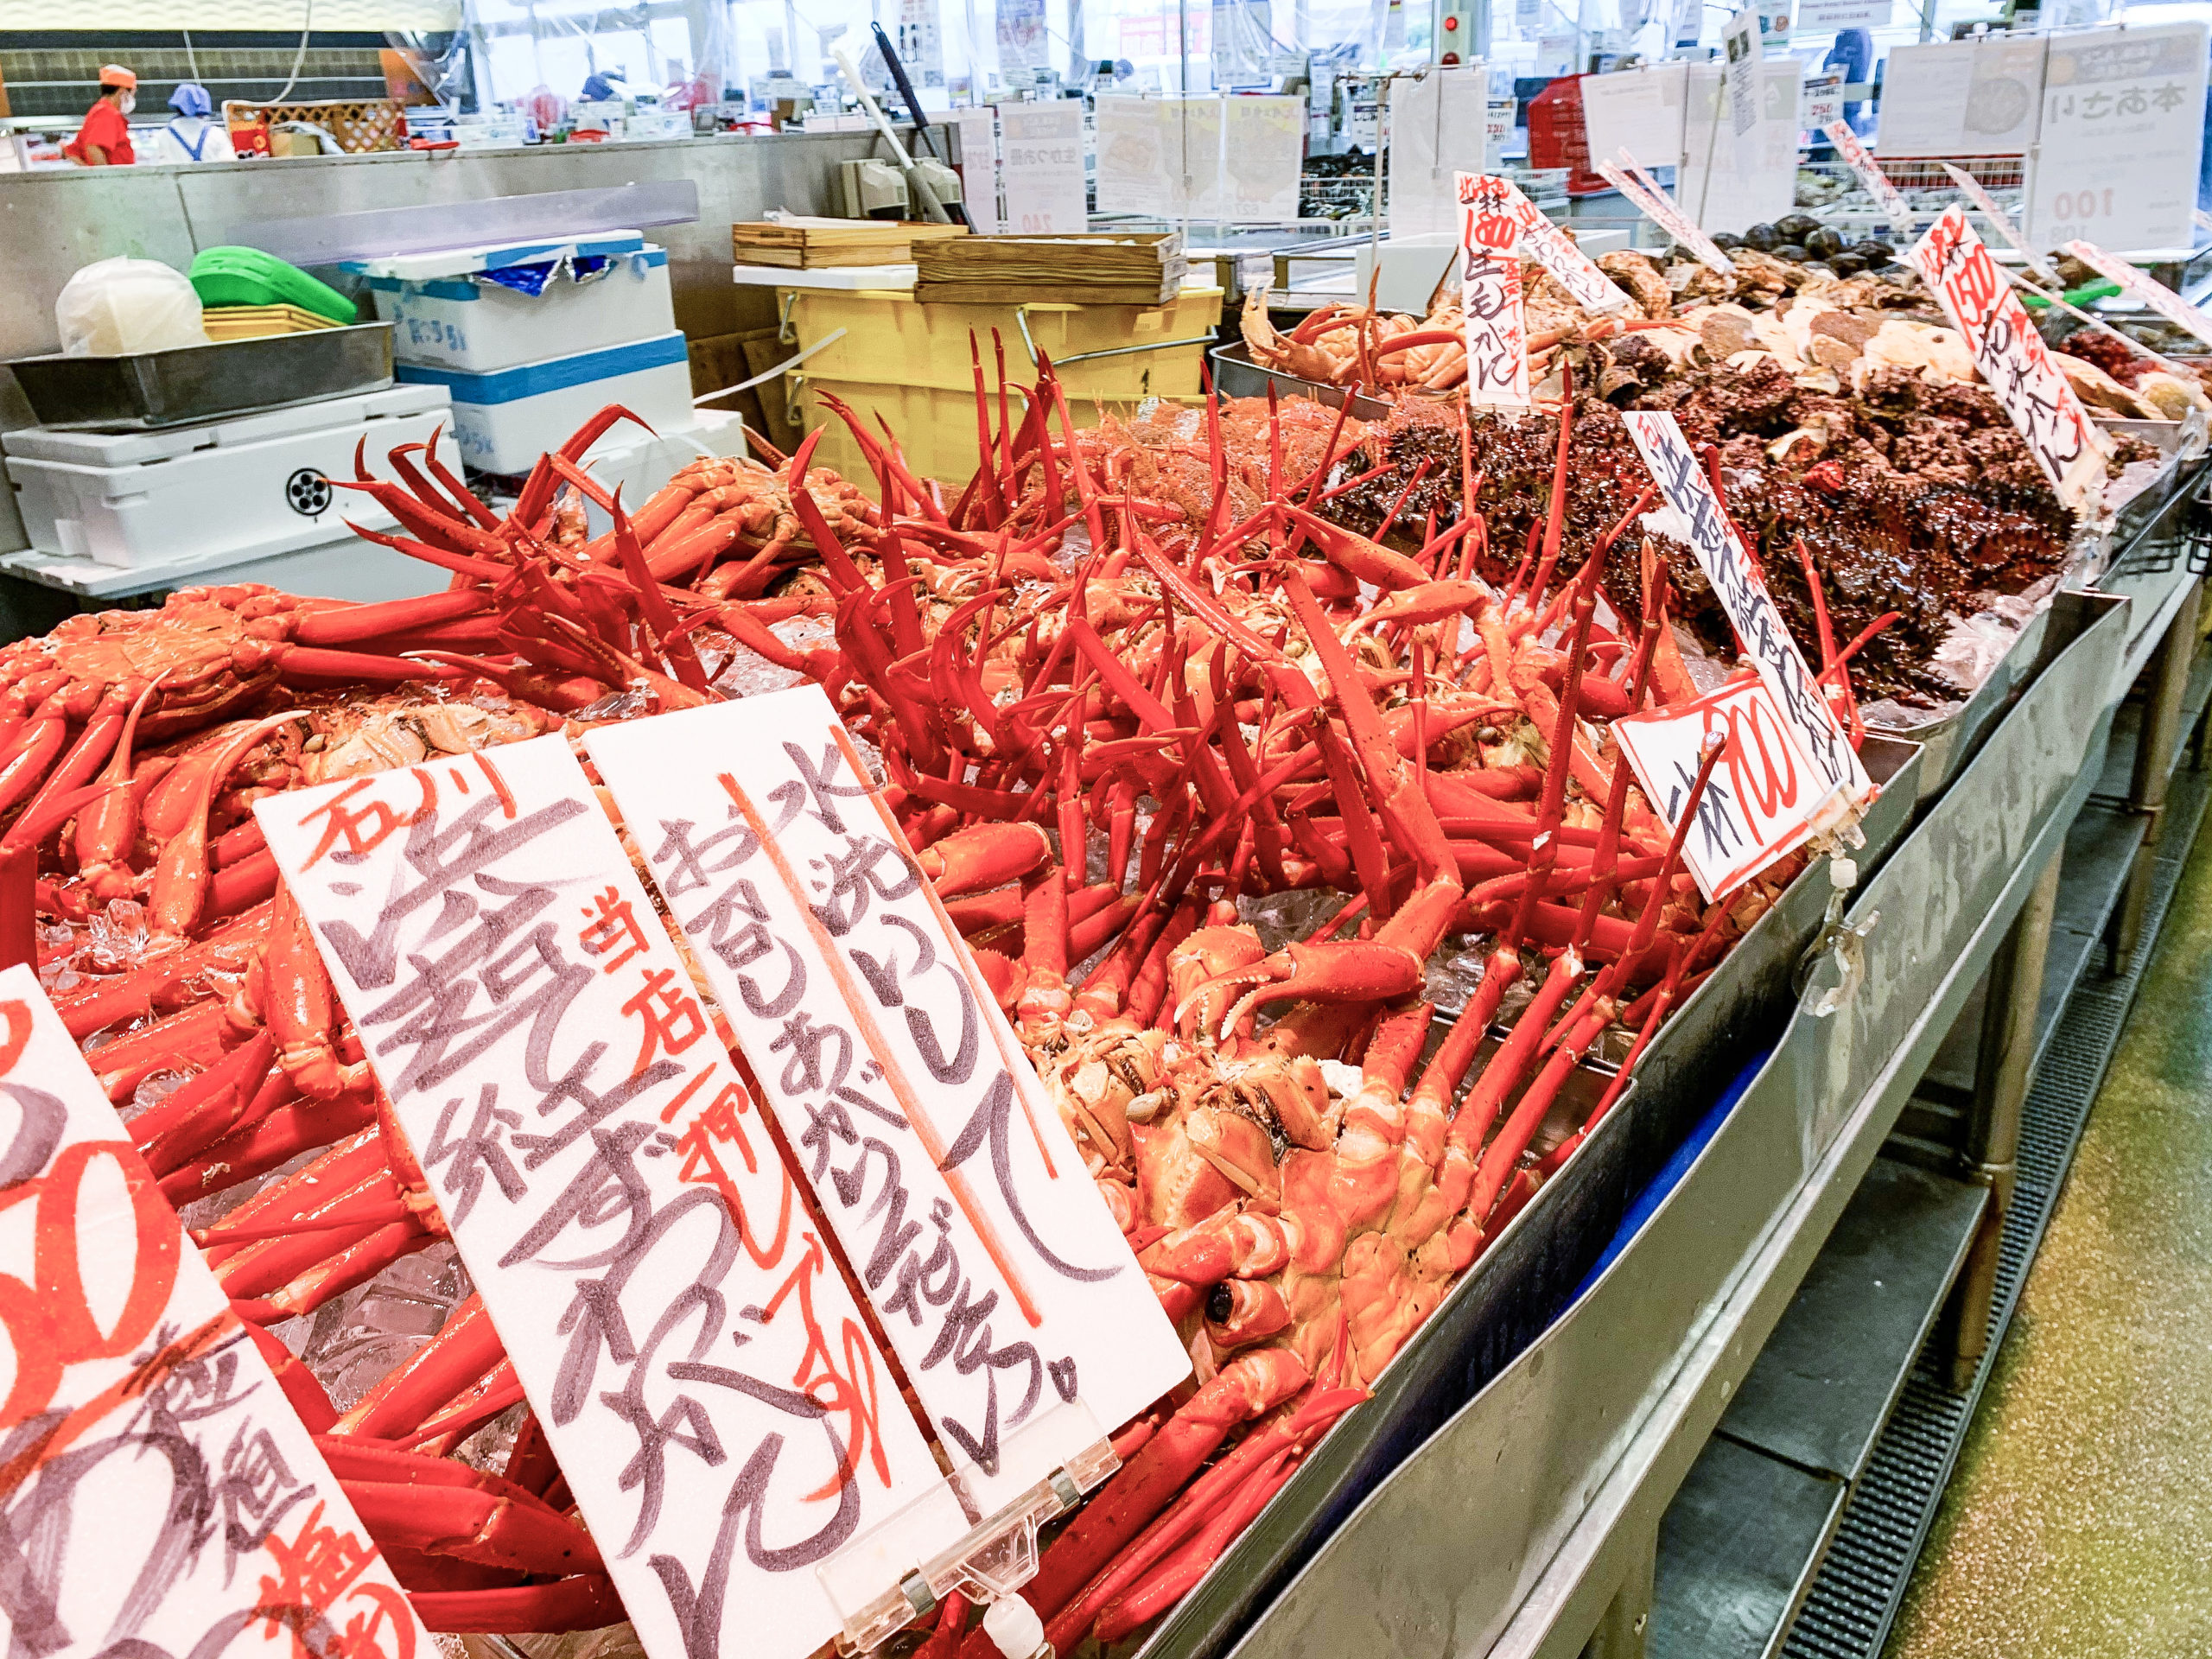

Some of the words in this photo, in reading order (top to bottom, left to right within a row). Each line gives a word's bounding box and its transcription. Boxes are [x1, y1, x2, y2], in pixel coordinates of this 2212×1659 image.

[1465, 208, 1516, 249] 1800
[1945, 243, 1997, 353] 1500
[299, 750, 518, 873] 石川
